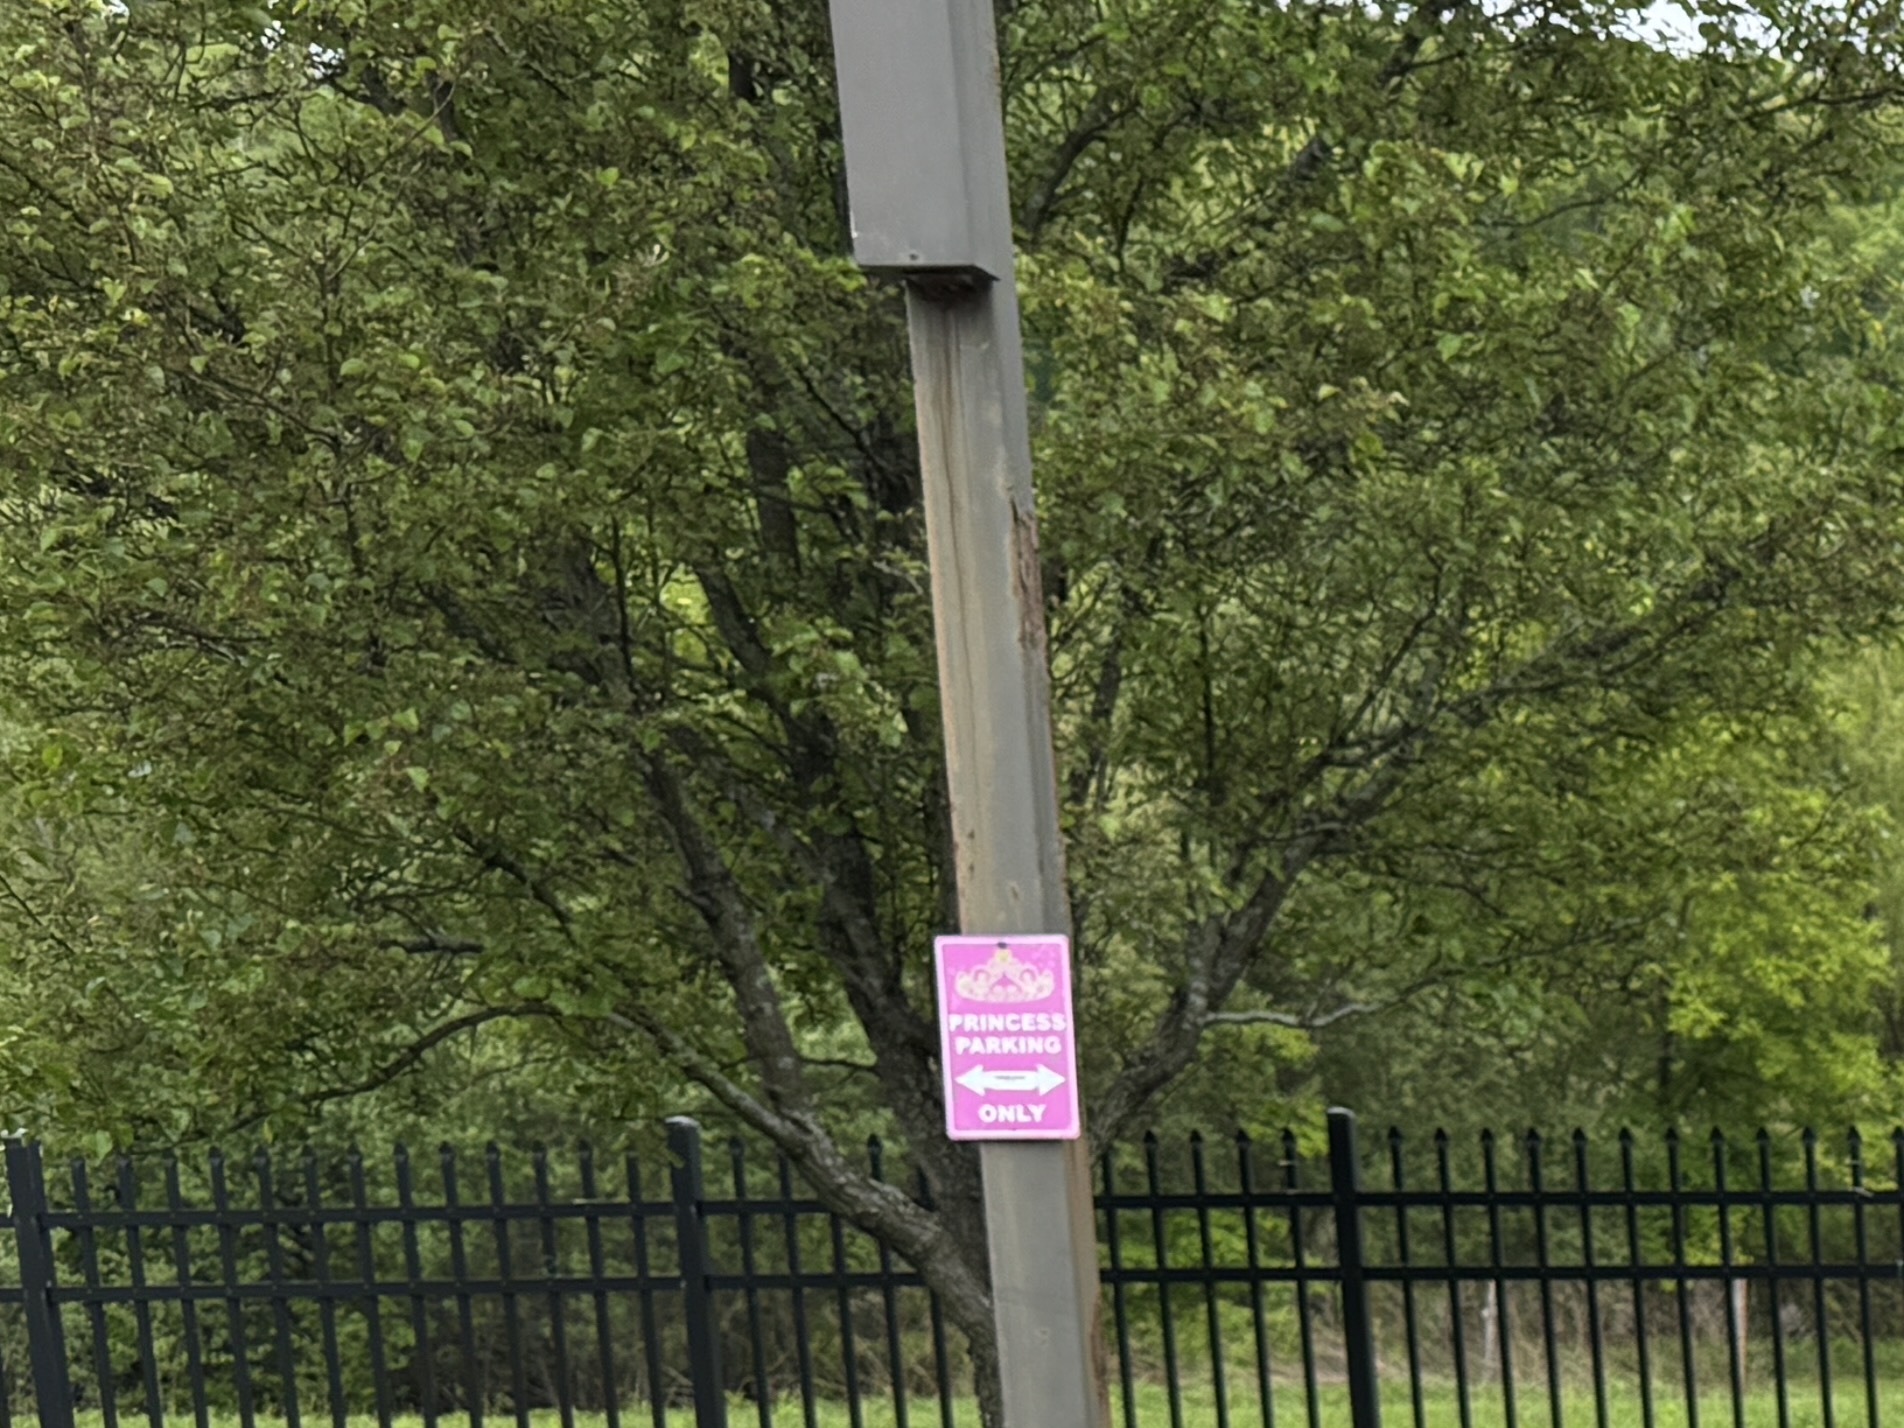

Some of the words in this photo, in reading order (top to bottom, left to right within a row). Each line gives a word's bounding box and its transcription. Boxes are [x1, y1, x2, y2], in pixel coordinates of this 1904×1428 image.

[949, 1013, 1067, 1032] PRINCESS
[955, 1036, 1062, 1055] PARKING
[978, 1103, 1047, 1123] ONLY
